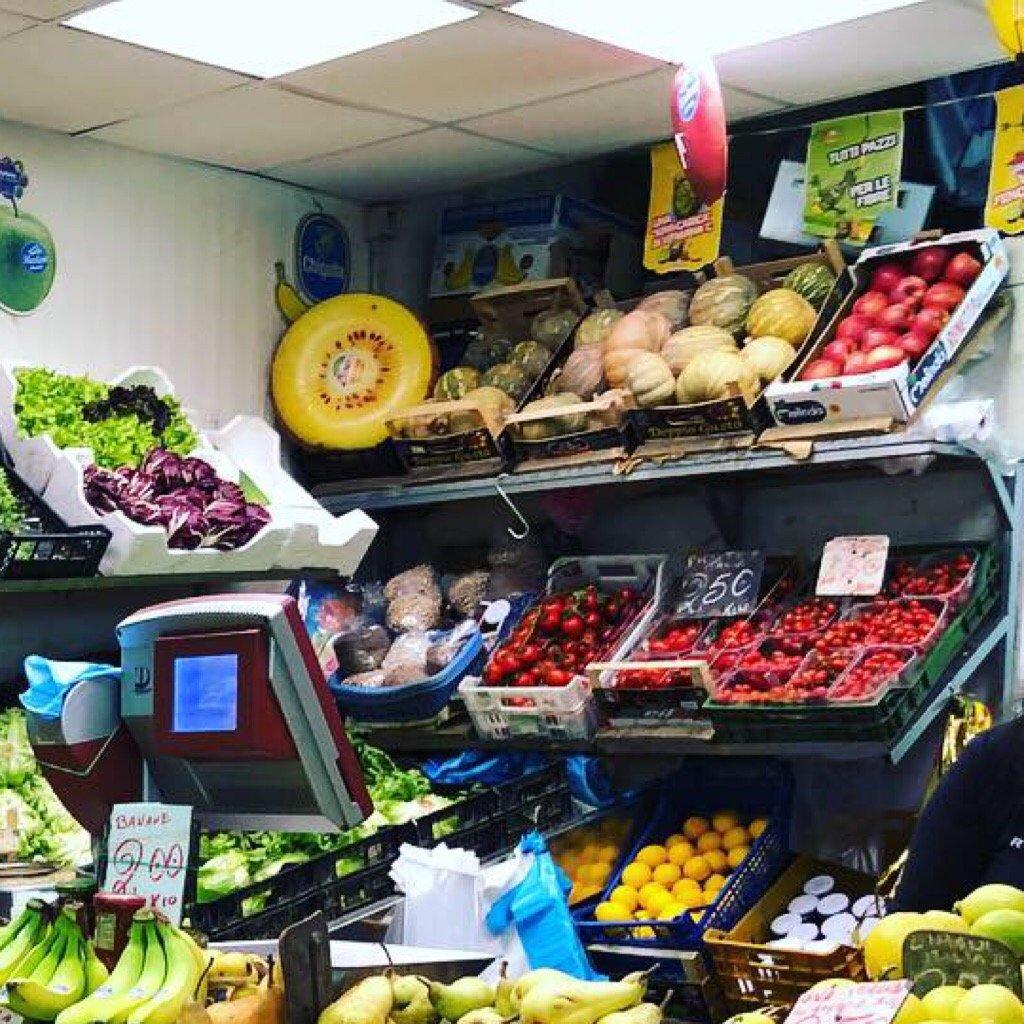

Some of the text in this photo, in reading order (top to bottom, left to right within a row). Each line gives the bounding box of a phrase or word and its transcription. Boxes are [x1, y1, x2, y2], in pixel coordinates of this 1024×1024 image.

[829, 133, 897, 165] TUTTI PAZZI
[850, 175, 891, 198] PER LE
